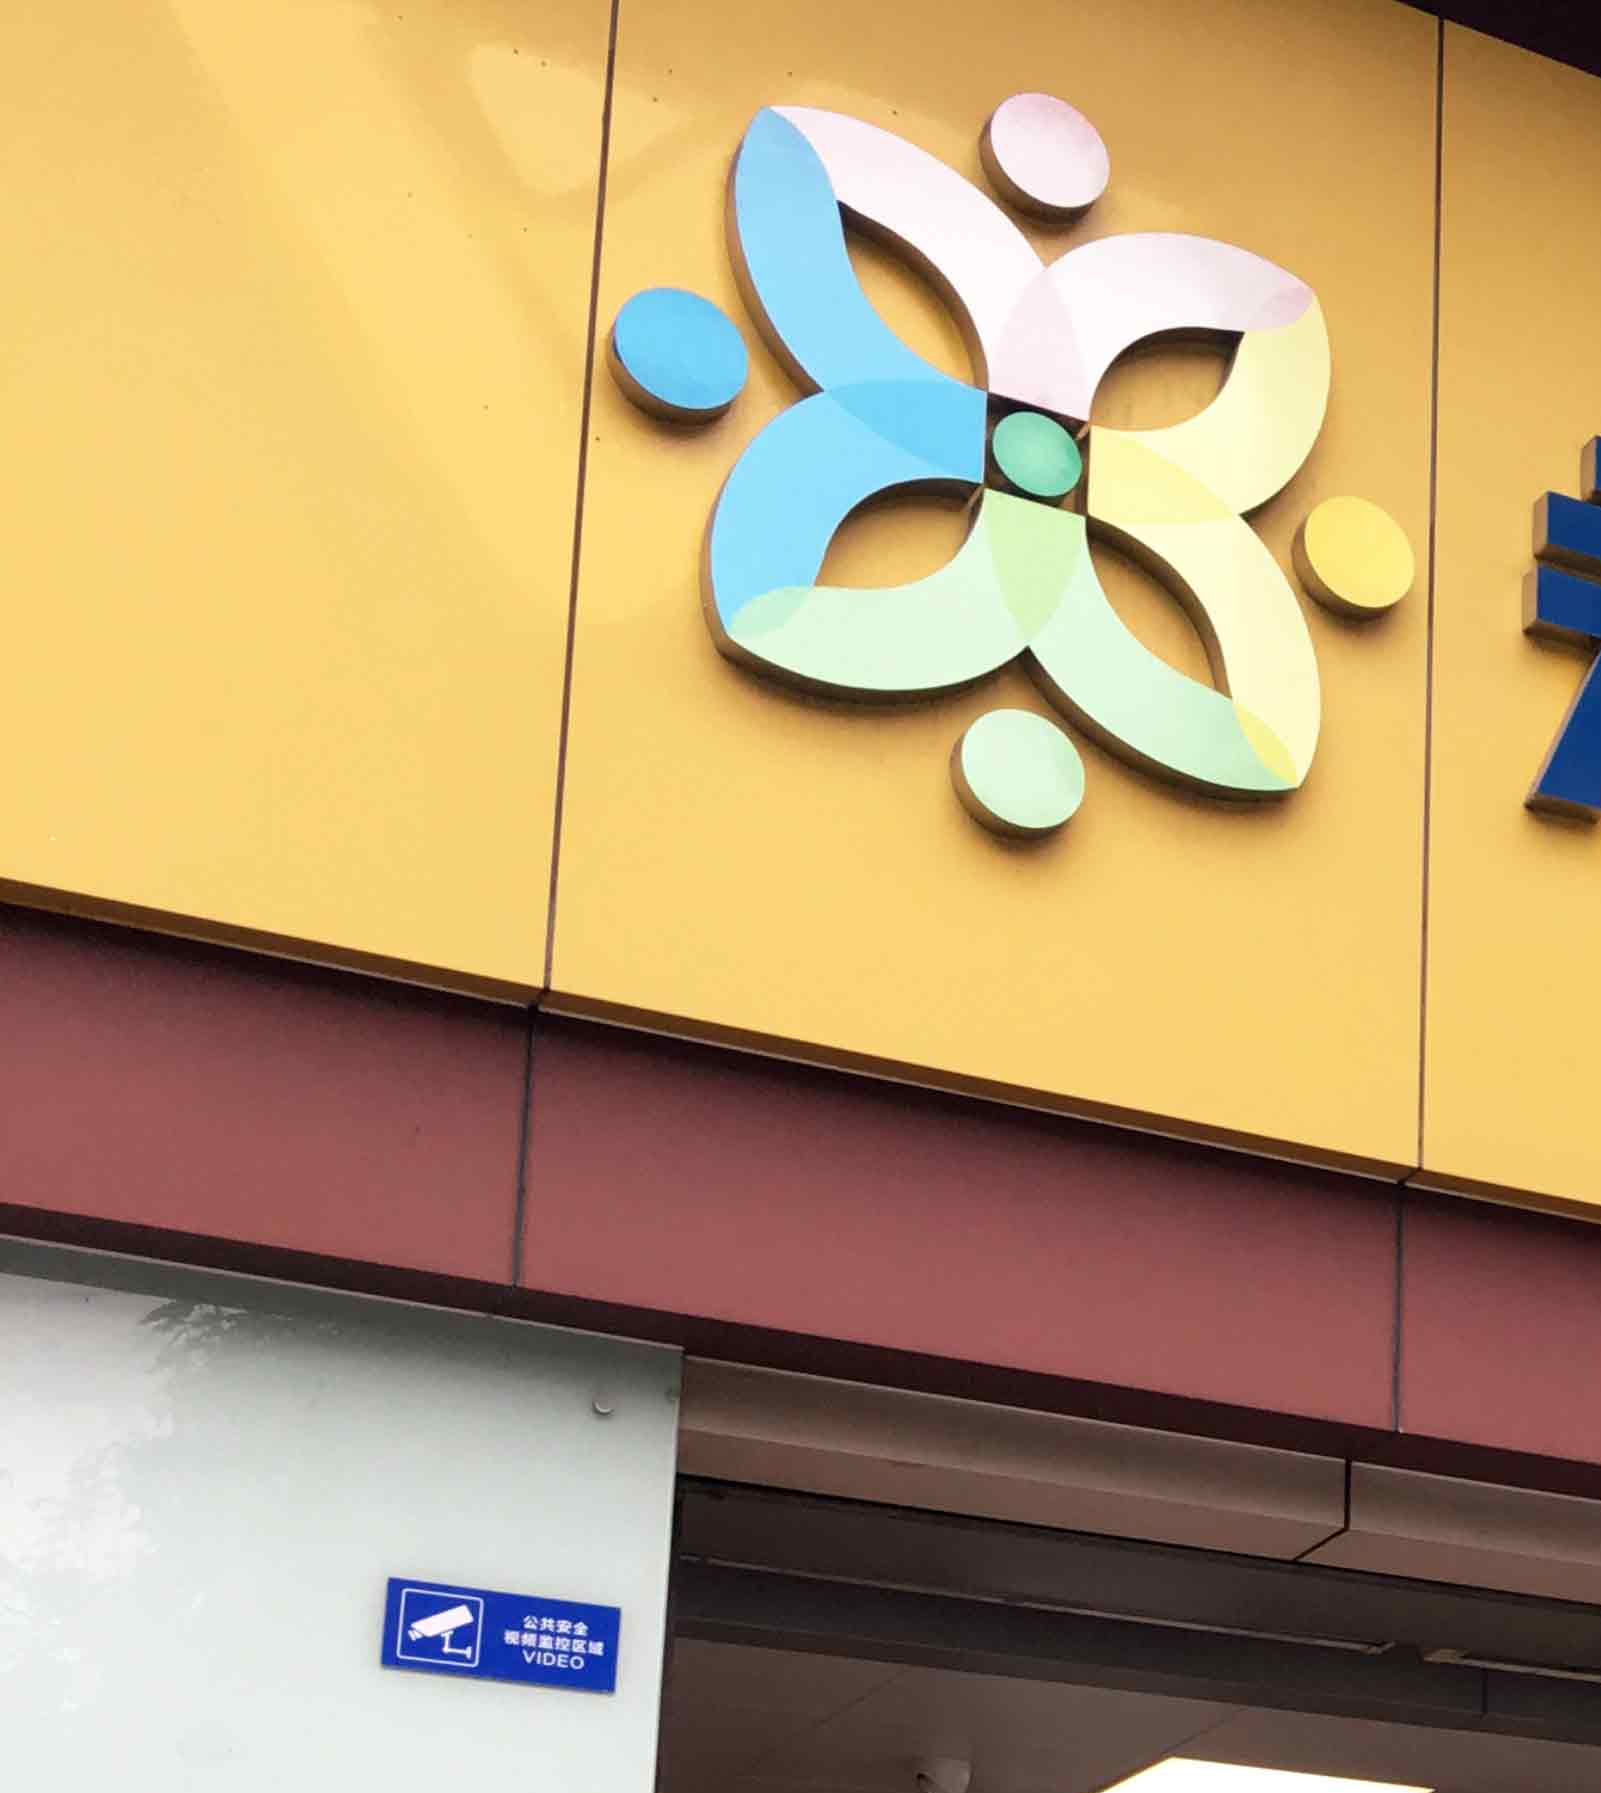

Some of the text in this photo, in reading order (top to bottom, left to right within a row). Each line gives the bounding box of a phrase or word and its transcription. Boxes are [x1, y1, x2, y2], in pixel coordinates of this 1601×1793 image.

[523, 1615, 589, 1636] 公共安全
[503, 1630, 605, 1656] 视频监控区域
[522, 1650, 585, 1670] VIDEO
